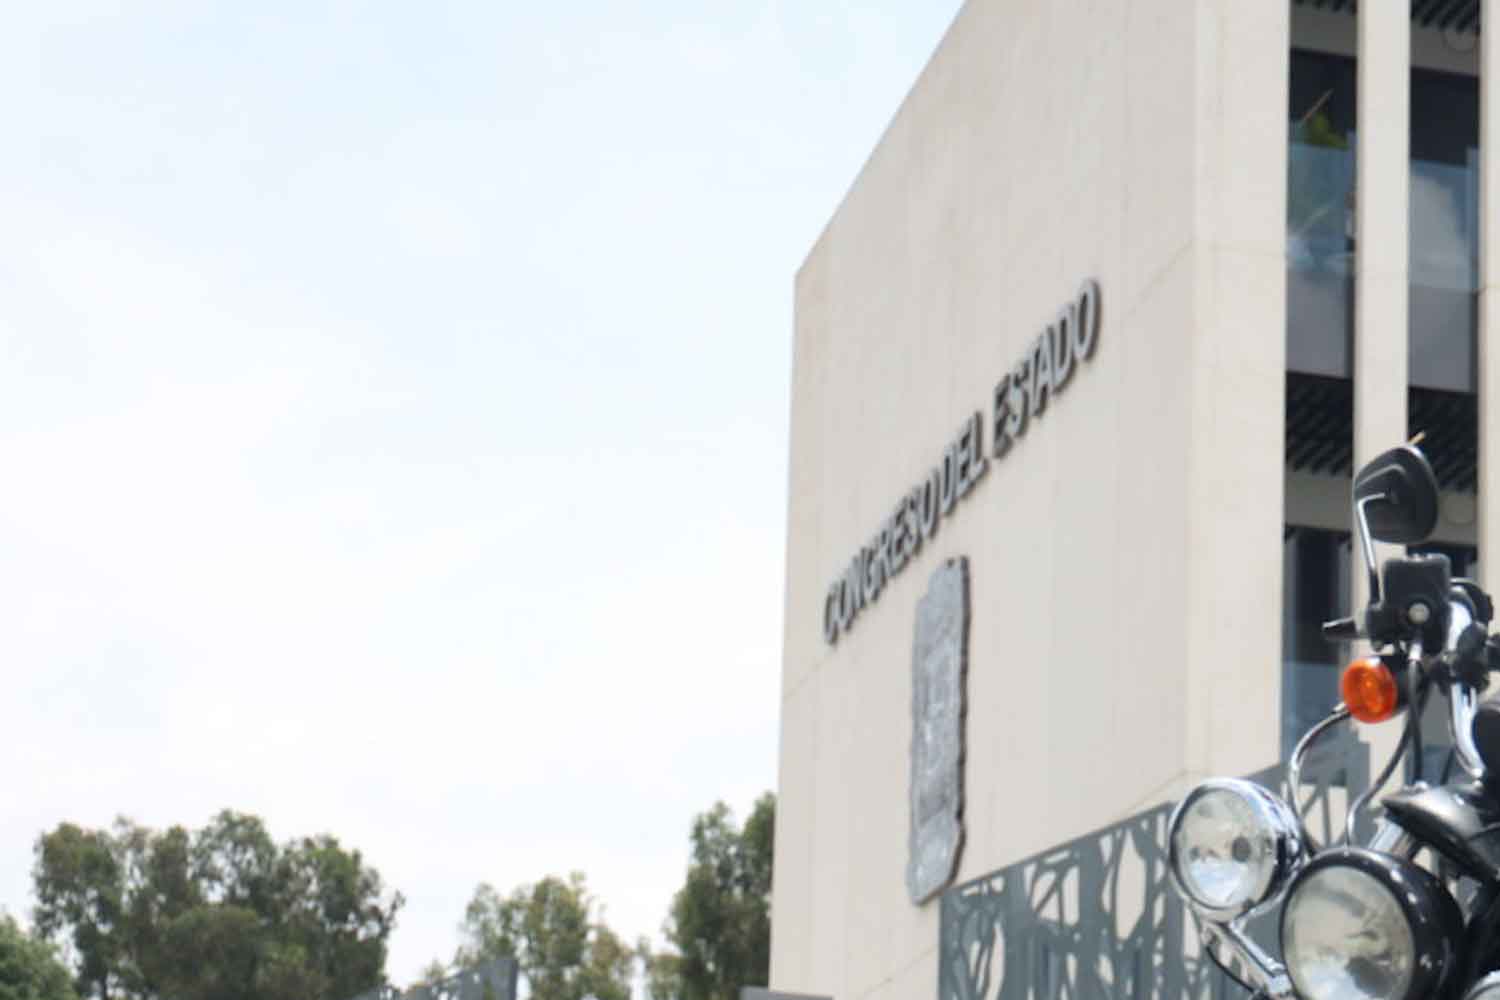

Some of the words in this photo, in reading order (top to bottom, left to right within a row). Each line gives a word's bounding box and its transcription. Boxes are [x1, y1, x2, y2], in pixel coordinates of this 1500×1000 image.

[824, 466, 940, 645] CONGRESO
[942, 411, 990, 517] DEL
[993, 278, 1101, 459] ESTADO
